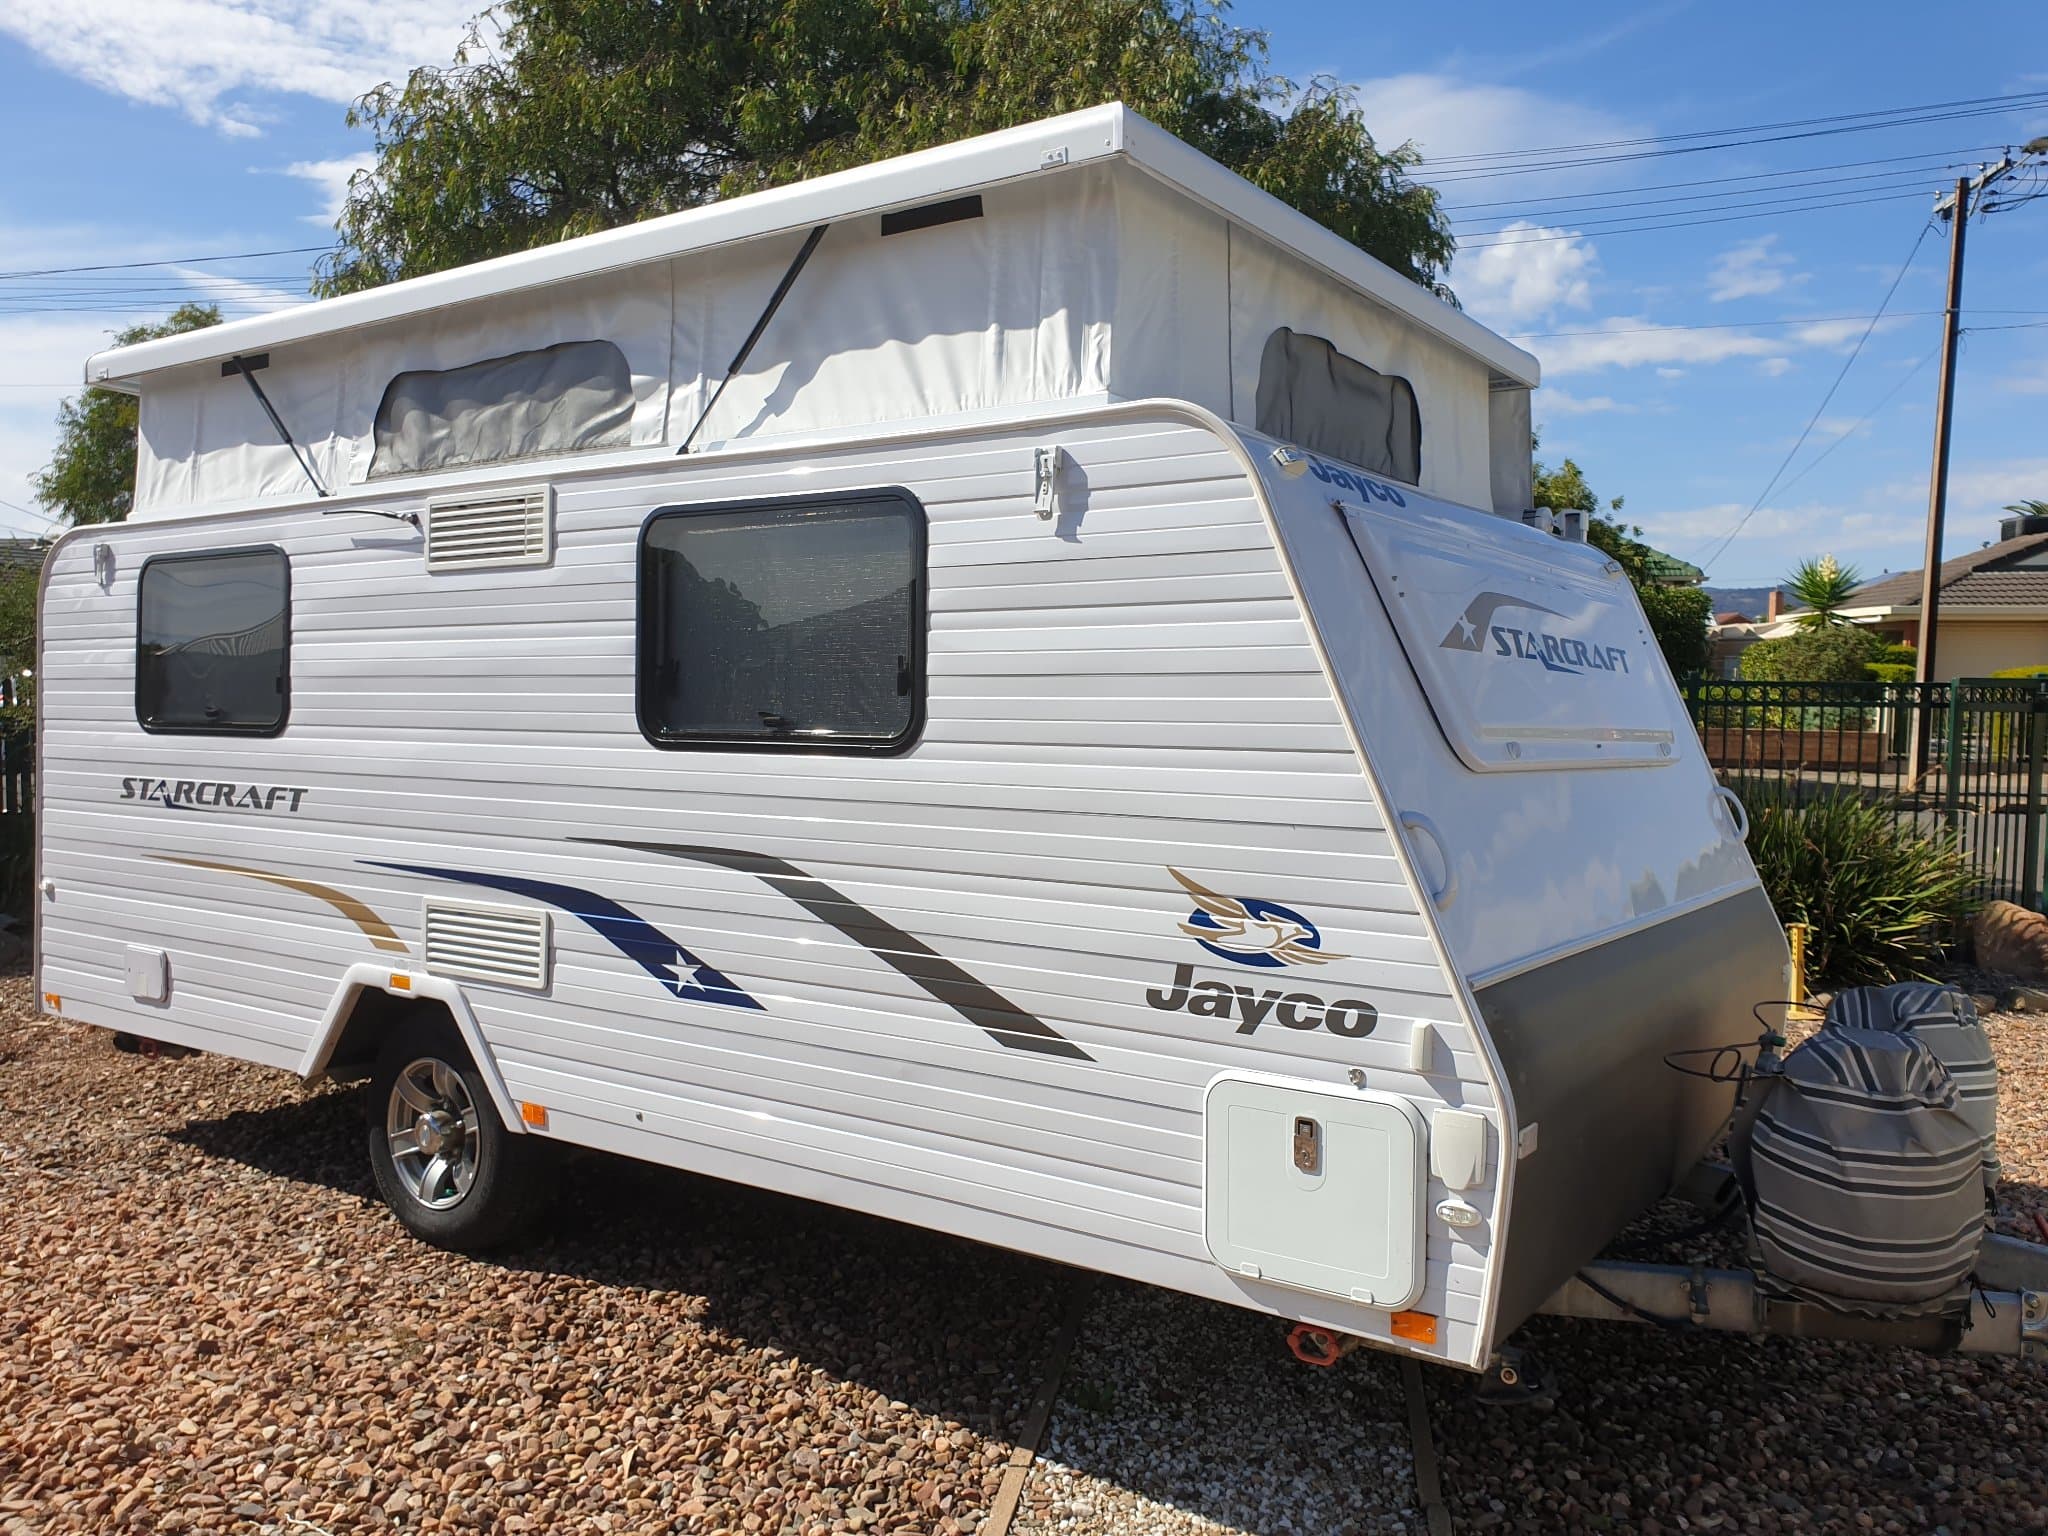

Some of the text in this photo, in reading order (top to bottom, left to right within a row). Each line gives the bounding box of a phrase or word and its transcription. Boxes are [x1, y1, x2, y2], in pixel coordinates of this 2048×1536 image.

[1307, 454, 1406, 508] Jayco
[1491, 626, 1629, 675] STARCRAFT
[120, 777, 308, 813] STARCRAFT
[1146, 963, 1378, 1038] Jayco
